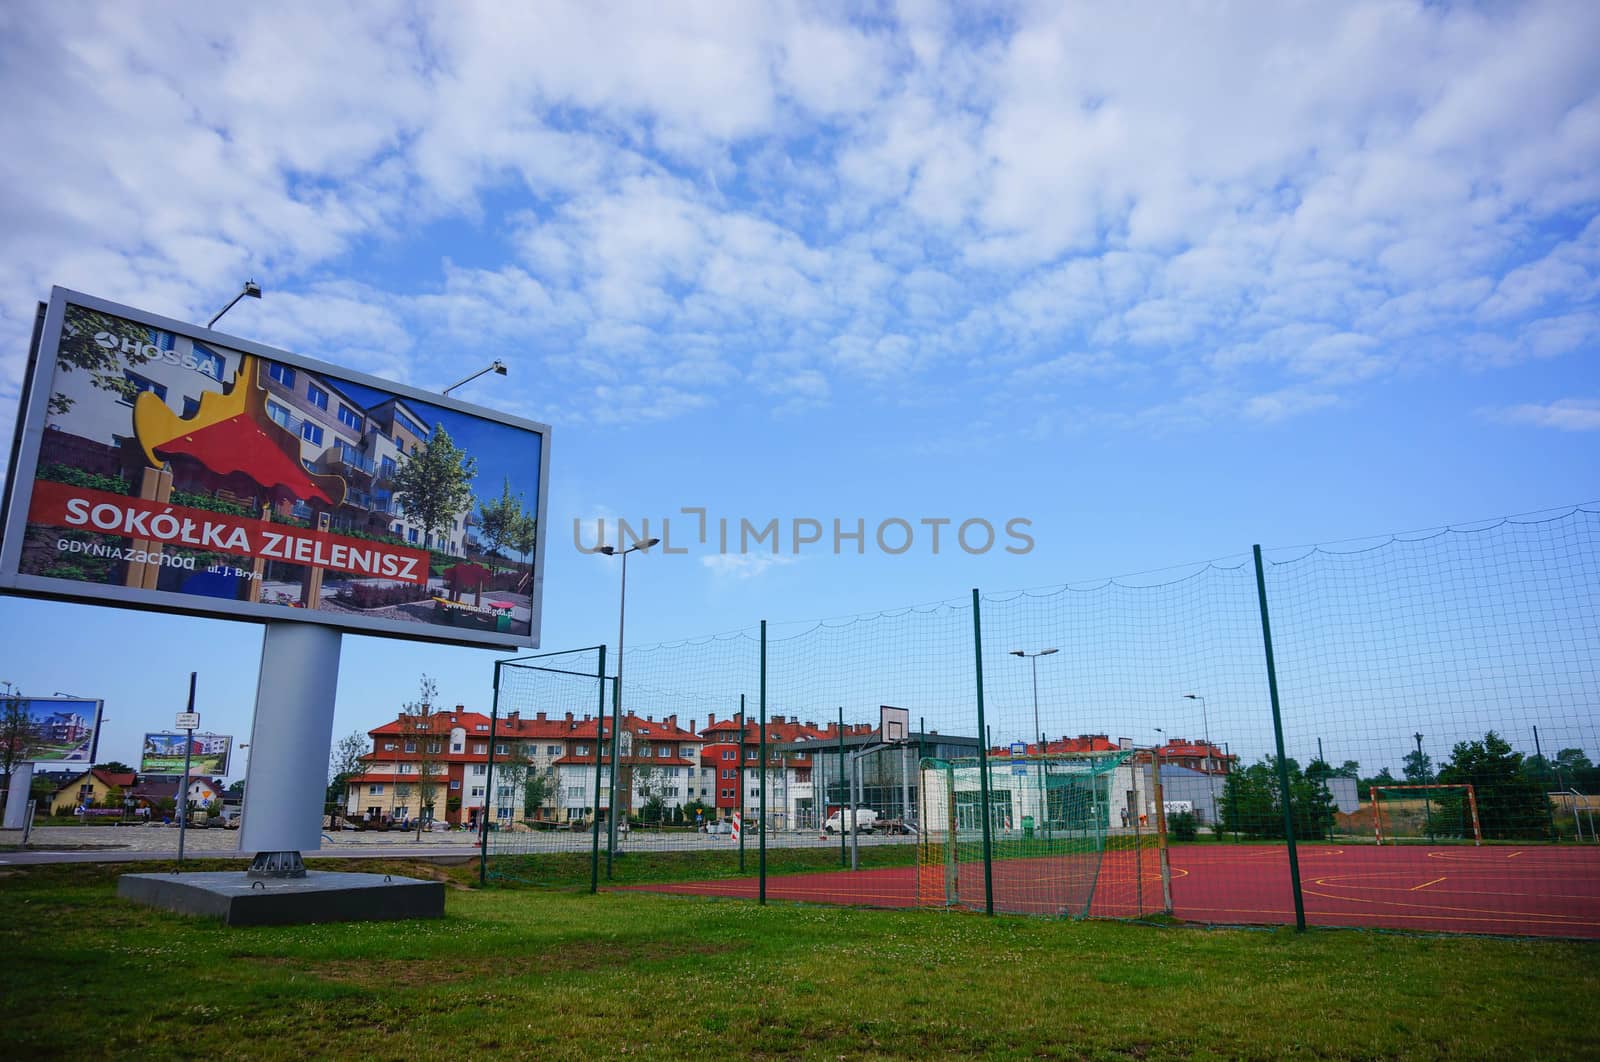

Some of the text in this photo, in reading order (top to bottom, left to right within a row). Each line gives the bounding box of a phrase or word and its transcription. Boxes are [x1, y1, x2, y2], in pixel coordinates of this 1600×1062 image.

[120, 337, 217, 376] HOSSA
[64, 498, 419, 580] SOKÓŁKA ZIELENISZ
[207, 565, 221, 574] ul.
[223, 566, 232, 577] J.
